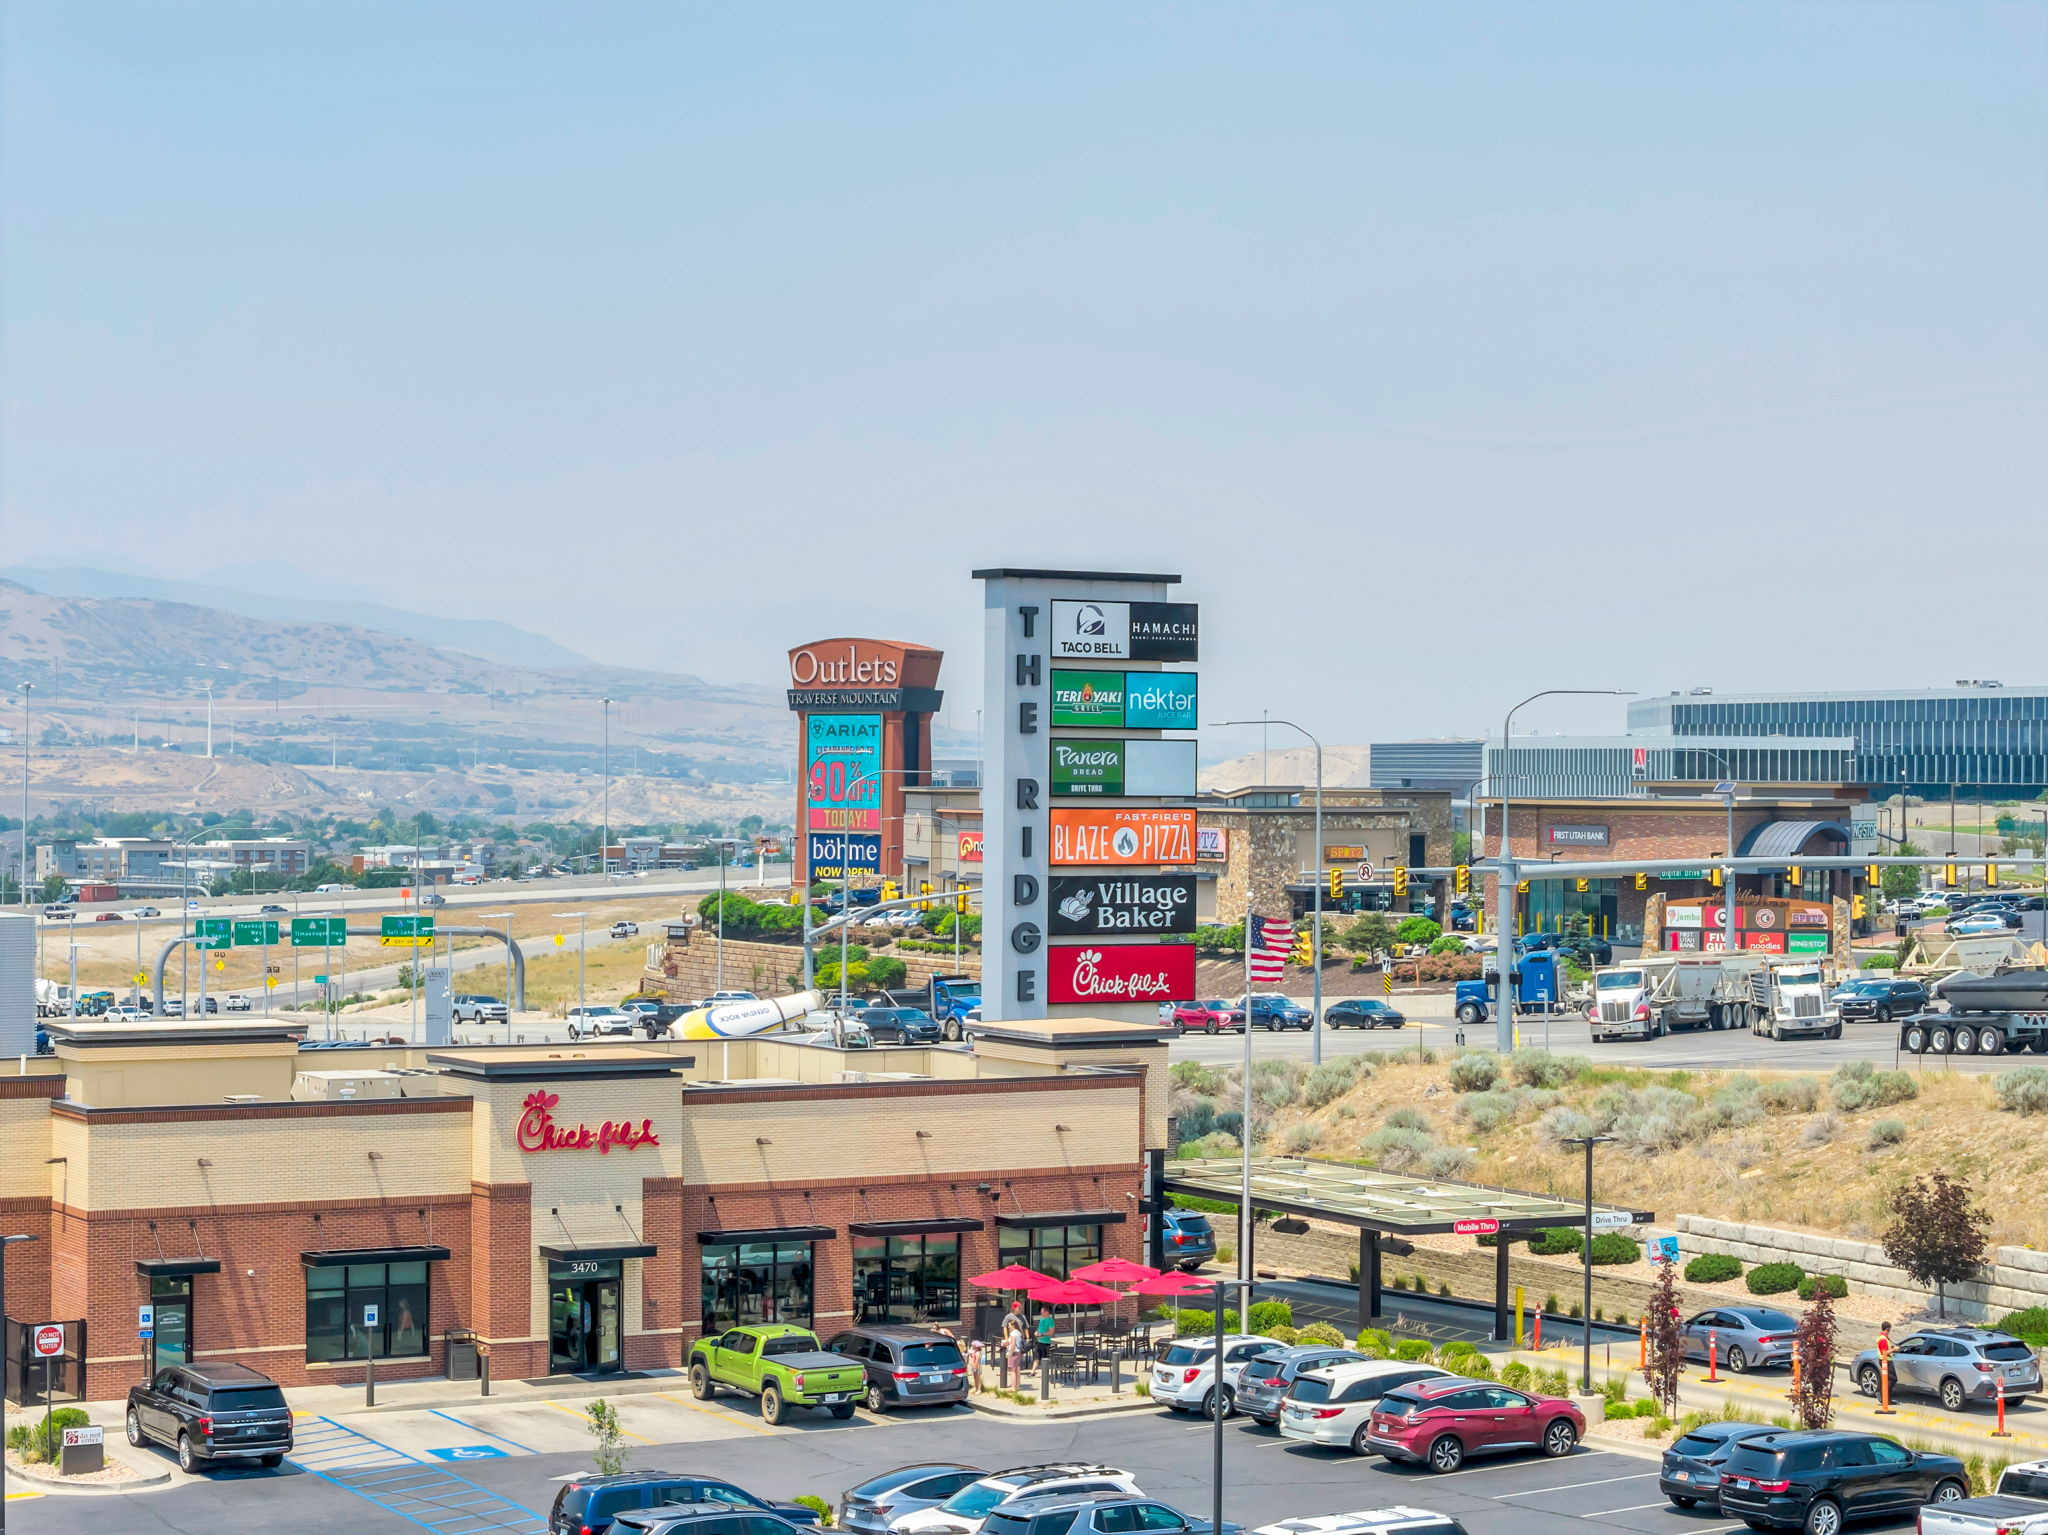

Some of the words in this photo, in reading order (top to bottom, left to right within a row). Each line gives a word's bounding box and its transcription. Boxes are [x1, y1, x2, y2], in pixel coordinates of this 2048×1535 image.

[1132, 622, 1196, 635] HAMACHI
[1060, 641, 1092, 653] TACO
[1094, 642, 1122, 654] BELL
[791, 645, 898, 684] Outlets
[1016, 606, 1041, 734] THE
[789, 692, 837, 704] TRAVERSE
[840, 692, 898, 704] MOUNTAIN
[1074, 703, 1101, 712] GRILL
[1156, 711, 1176, 719] JUICE
[825, 724, 879, 737] ARIAT
[1055, 746, 1118, 767] Panera
[1072, 768, 1104, 776] BREAD
[849, 779, 877, 801] OFF
[1071, 784, 1087, 793] DRIVE
[1088, 784, 1103, 793] THRU
[823, 809, 868, 828] TODAY!
[1054, 824, 1110, 861] BLAZE
[1143, 823, 1191, 860] PIZZA
[1554, 831, 1569, 840] FIRST
[1569, 831, 1586, 840] UTAH
[1587, 831, 1605, 840] BANK
[812, 836, 878, 861] böhme
[815, 866, 843, 877] NOW
[1661, 870, 1682, 879] Digital
[1684, 869, 1701, 877] Drive
[1011, 778, 1042, 1001] RIDGE
[1097, 882, 1188, 910] Village
[1097, 905, 1176, 928] Baker
[1676, 912, 1701, 921] Jamba
[1792, 914, 1825, 923] SPITZ
[1749, 942, 1781, 950] noodles
[1072, 957, 1171, 998] Chick-fil-A
[516, 1104, 660, 1154] Chick-fil-A
[1595, 1216, 1612, 1224] Drive
[1612, 1215, 1628, 1223] Thru
[1457, 1223, 1479, 1232] Mobile
[1480, 1222, 1496, 1230] Thru
[571, 1262, 598, 1273] 3470
